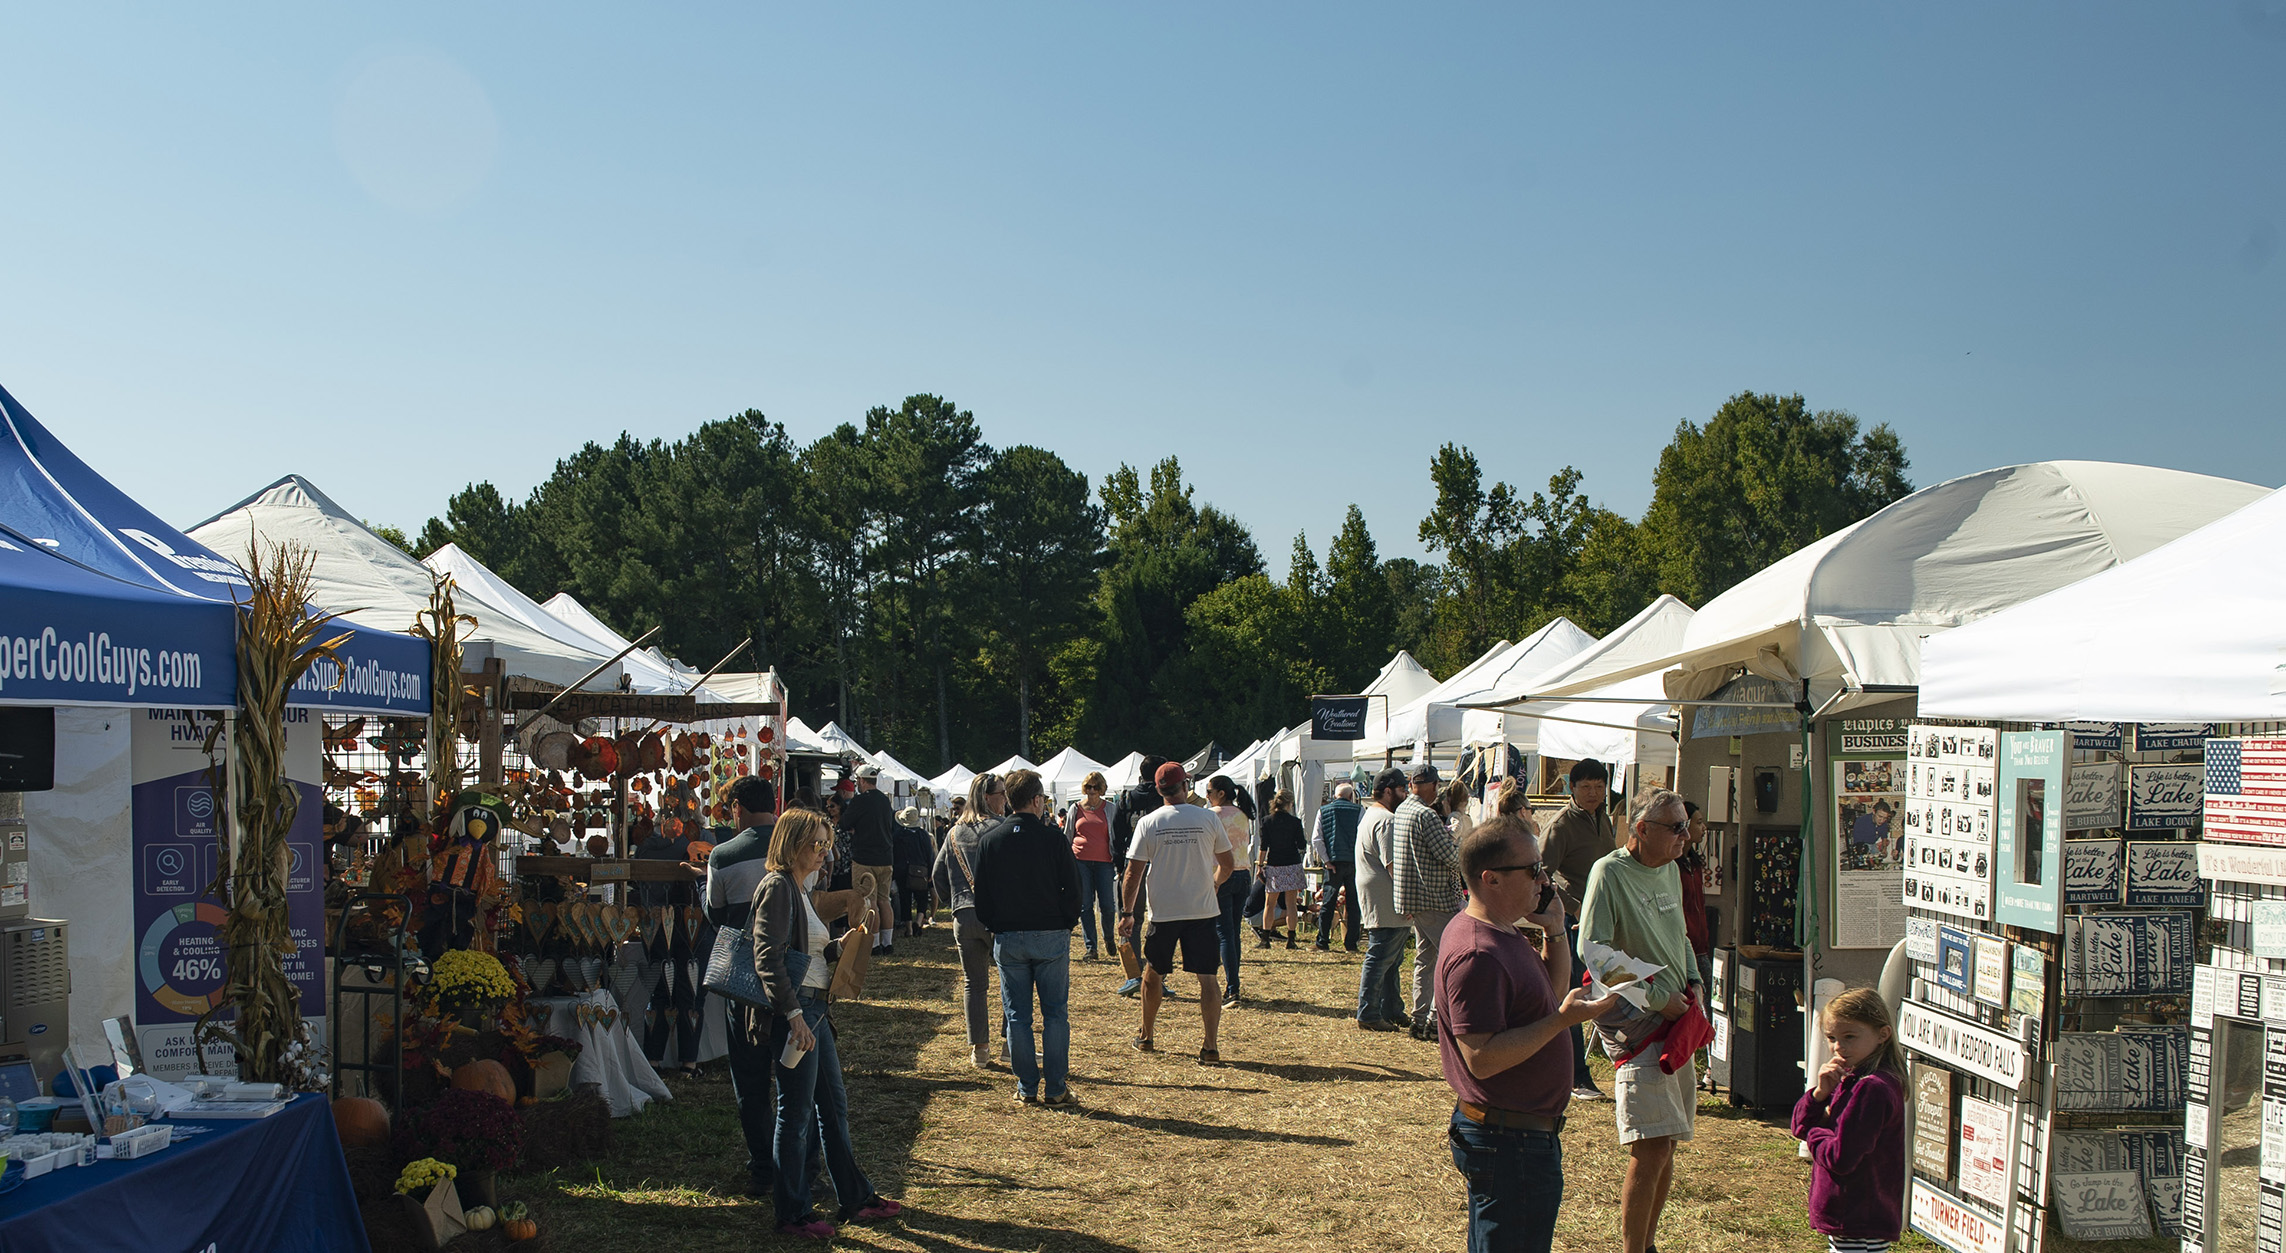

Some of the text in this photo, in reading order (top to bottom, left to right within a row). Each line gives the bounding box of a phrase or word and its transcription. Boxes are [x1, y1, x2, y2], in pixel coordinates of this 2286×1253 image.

[1317, 708, 1361, 720] Weathered
[1323, 718, 1357, 731] Creations
[2030, 736, 2054, 754] BRAVER
[2073, 738, 2118, 748] HARTWELL
[2145, 737, 2205, 748] LAKE CHATUG
[2081, 770, 2104, 782] better
[2146, 771, 2197, 783] Life is better
[2144, 782, 2195, 805] Lake
[2077, 815, 2113, 826] BURTON
[2136, 817, 2161, 827] LAKE
[2166, 816, 2197, 826] OCONE
[2076, 847, 2083, 856] is
[2084, 846, 2106, 858] better
[2143, 848, 2194, 860] Life is better
[2140, 860, 2192, 882] Lake
[2070, 893, 2115, 902] HARTWELL
[2136, 895, 2196, 904] LAKE LANIER
[179, 937, 214, 946] HEATING
[2089, 931, 2100, 955] better
[173, 947, 220, 956] & COOLING
[2101, 932, 2122, 983] Lake
[2136, 924, 2147, 986] LAKE LANIER
[2171, 920, 2182, 988] LAKE OCONEE
[172, 958, 221, 980] 46%
[296, 961, 305, 970] IN
[165, 1037, 186, 1047] ASK
[1904, 1011, 2016, 1078] YOU ARE NOW IN BEDFORD FALLS
[153, 1060, 224, 1072] MEMBERS RCEIVE
[2108, 1038, 2118, 1081] SINCLAIR
[2072, 1048, 2096, 1099] Lake
[2155, 1038, 2166, 1107] LAKE HARTWELL
[1919, 1072, 1945, 1096] WELCOME
[2266, 1103, 2284, 1125] LIFE
[2157, 1146, 2166, 1168] SEED
[2070, 1179, 2080, 1190] Go
[2083, 1177, 2102, 1188] Jump
[2112, 1177, 2124, 1187] the
[2164, 1182, 2174, 1192] Go
[2077, 1187, 2129, 1213] Lake
[1931, 1197, 1985, 1246] TURNER FIELD
[2077, 1228, 2103, 1238] LAKE
